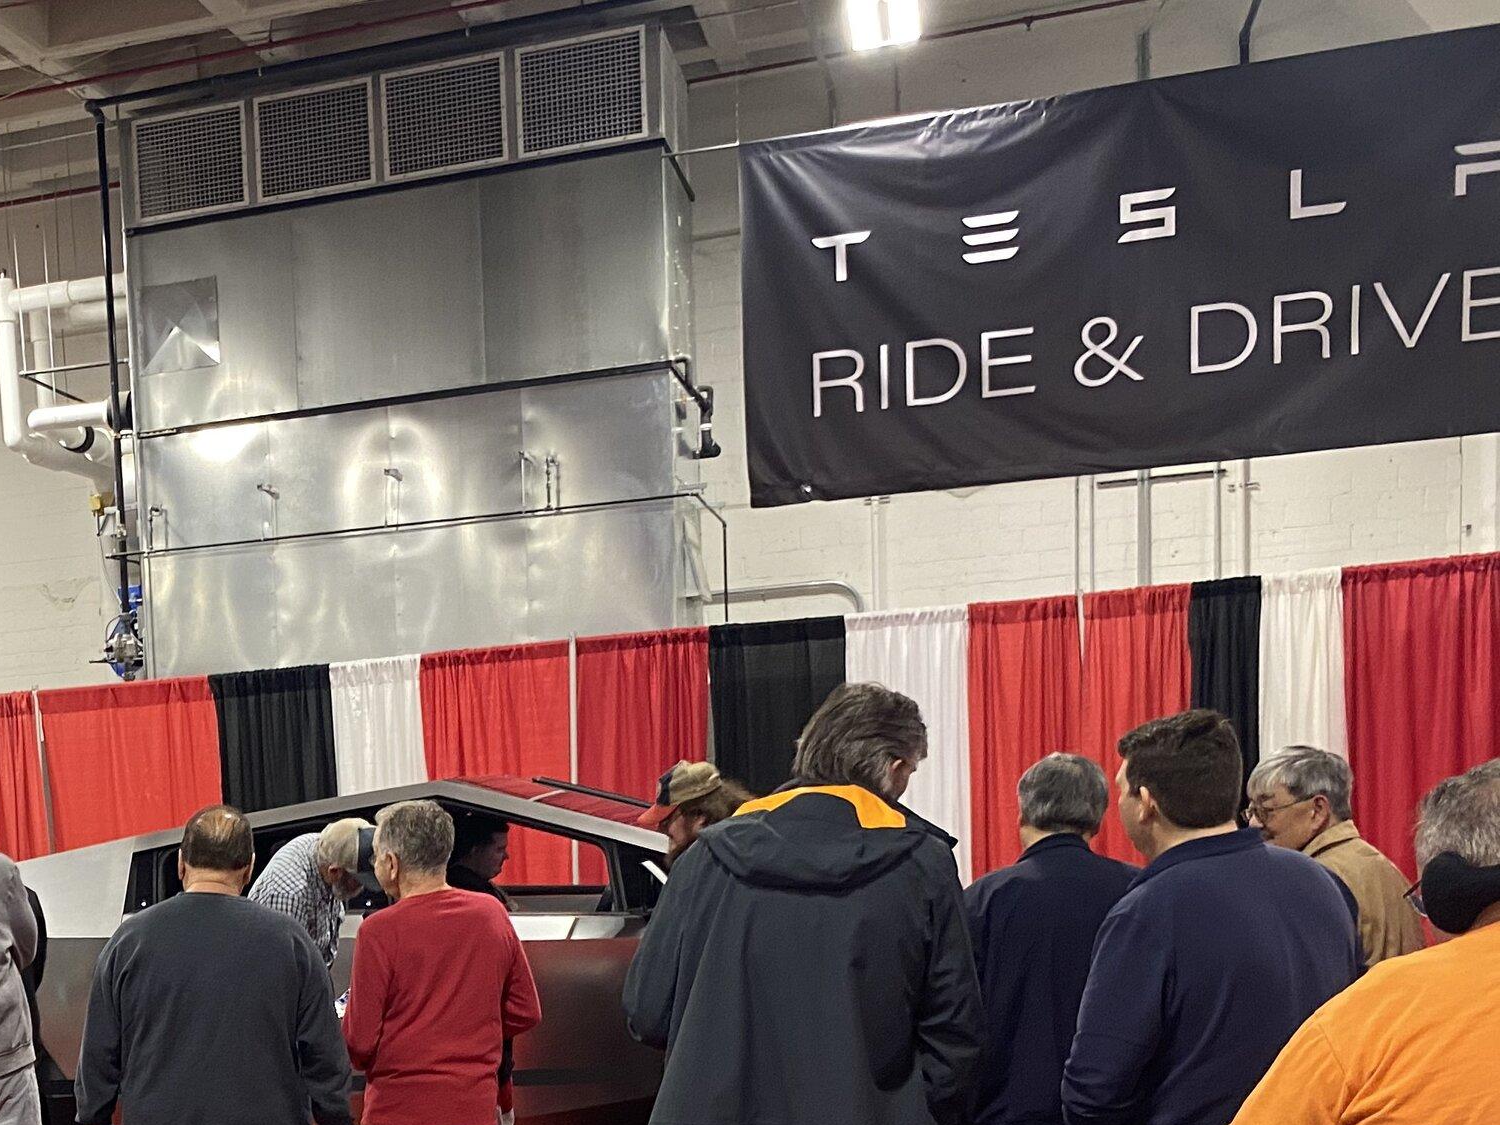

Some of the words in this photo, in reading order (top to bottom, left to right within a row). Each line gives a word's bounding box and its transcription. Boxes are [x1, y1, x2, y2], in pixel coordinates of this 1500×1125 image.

[811, 326, 1037, 418] RIDE
[1073, 316, 1145, 388] &
[1189, 267, 1500, 375] DRIVE
